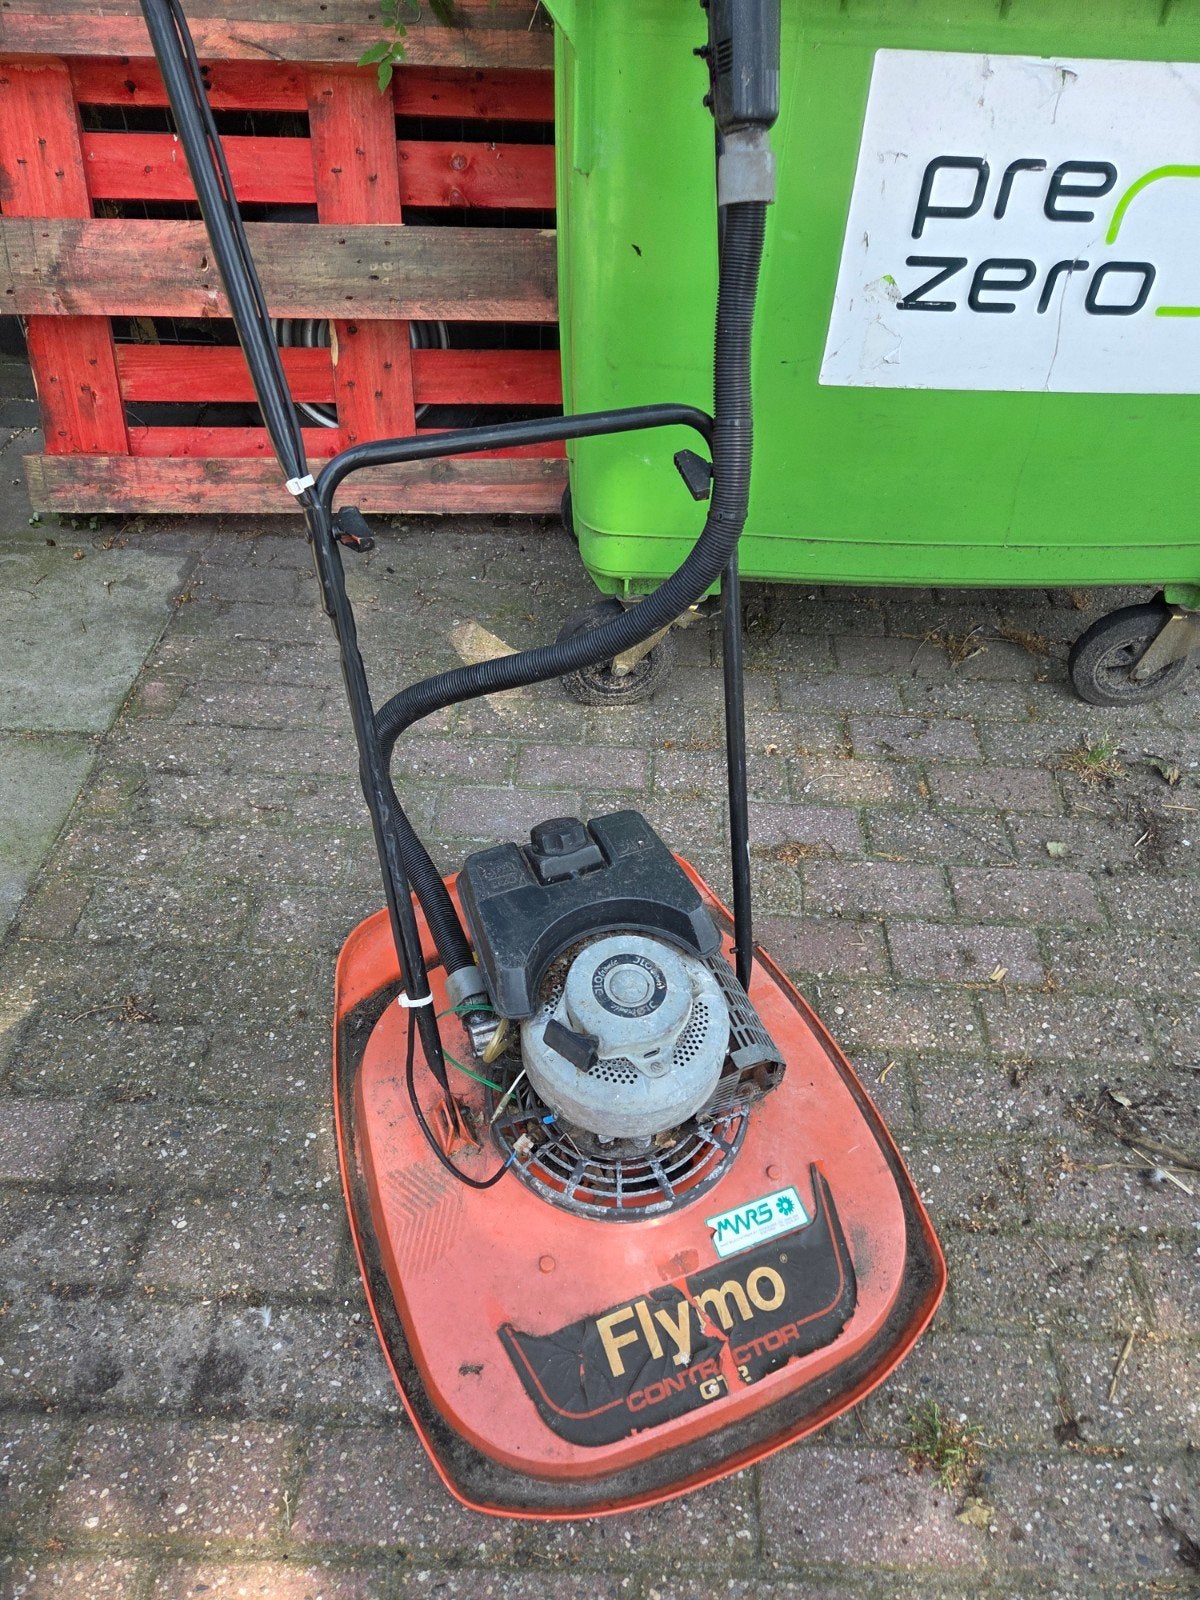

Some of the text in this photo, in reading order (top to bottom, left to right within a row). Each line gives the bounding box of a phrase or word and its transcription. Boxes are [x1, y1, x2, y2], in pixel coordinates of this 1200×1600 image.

[911, 155, 1118, 239] pre
[896, 255, 1156, 315] zero
[717, 1202, 773, 1242] MARS
[595, 1266, 786, 1378] Flymo
[626, 1323, 800, 1412] CONTRCTOR
